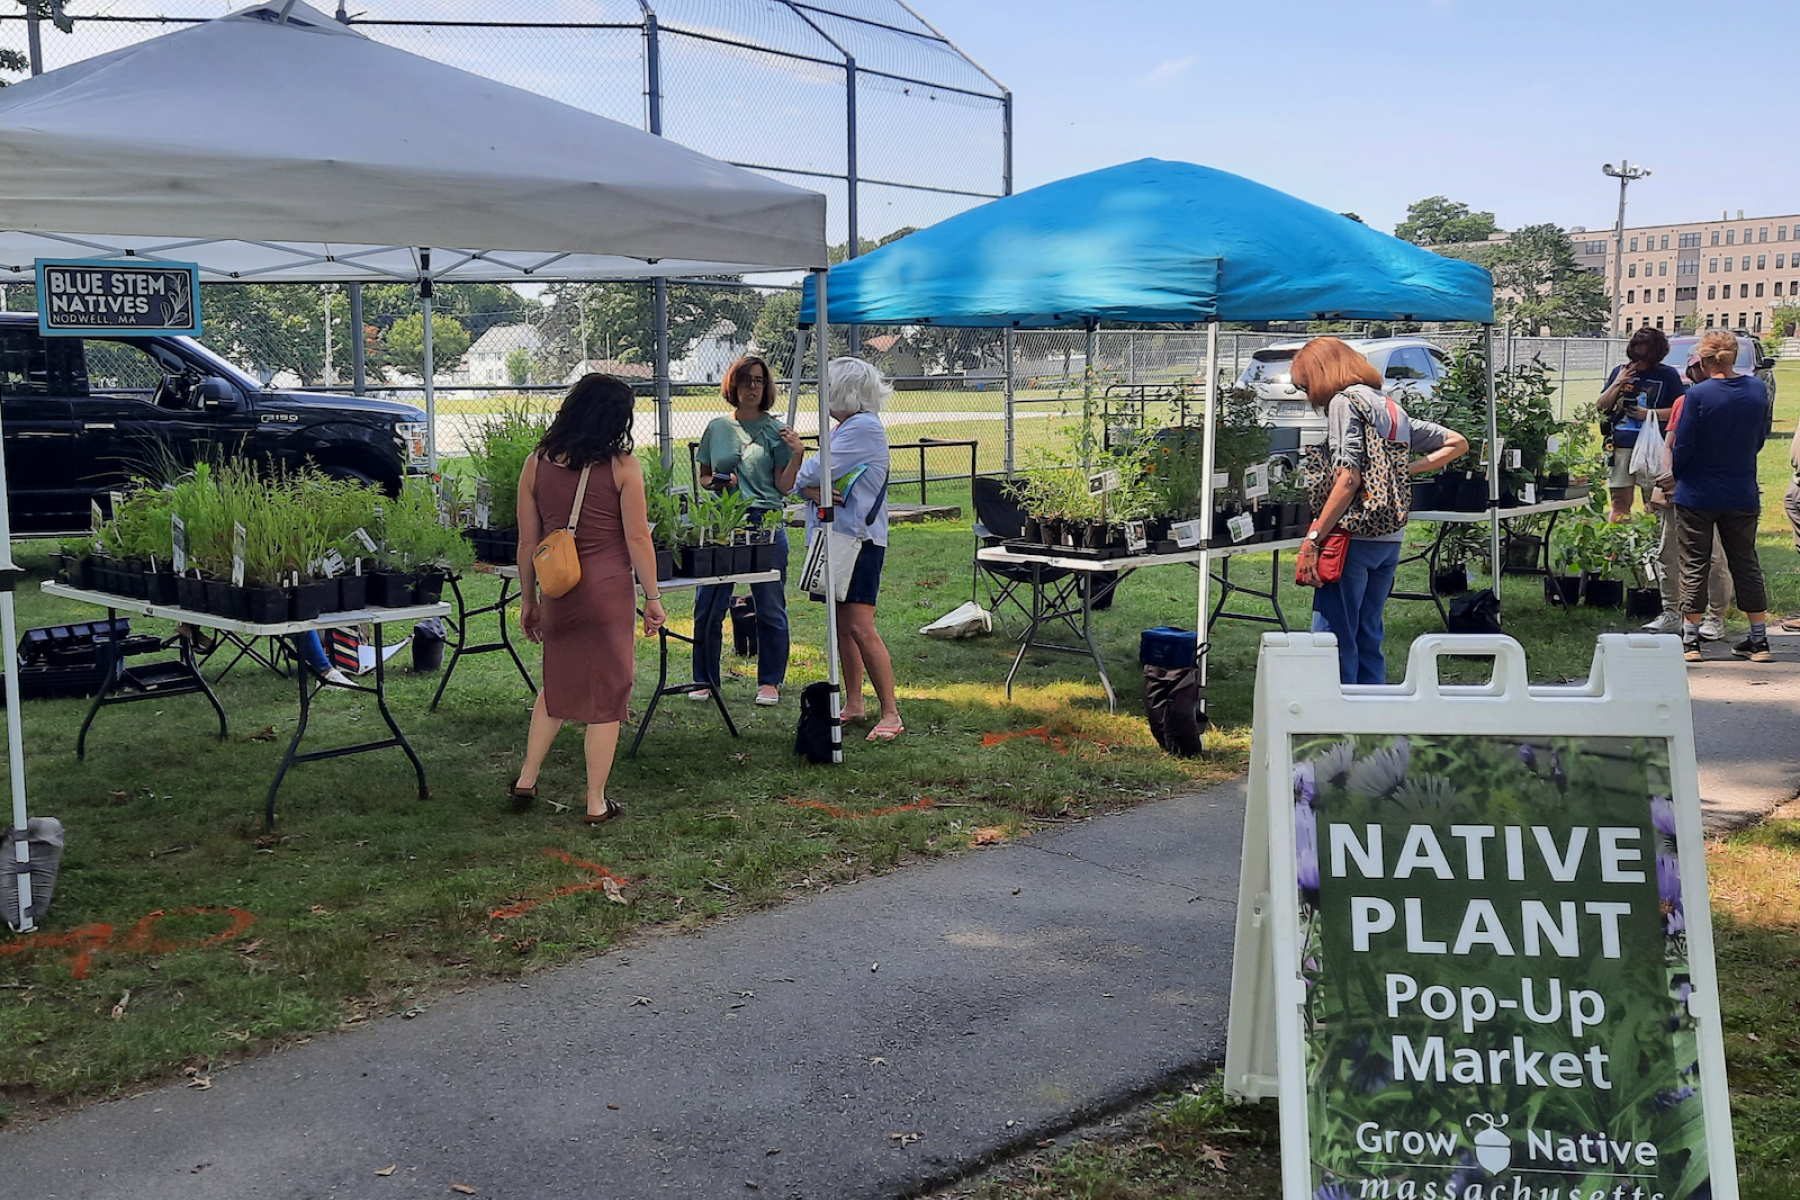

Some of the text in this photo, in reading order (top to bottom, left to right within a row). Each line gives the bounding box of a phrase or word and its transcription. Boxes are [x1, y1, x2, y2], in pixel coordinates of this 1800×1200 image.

[50, 272, 165, 295] BLUE STEM
[52, 295, 150, 314] NATIVES
[118, 315, 137, 324] MA
[1329, 823, 1647, 884] NATIVE
[1351, 896, 1632, 959] PLANT
[1386, 973, 1606, 1038] Pop-Up
[1392, 1035, 1612, 1090] Market
[1356, 1121, 1659, 1167] Grow Native
